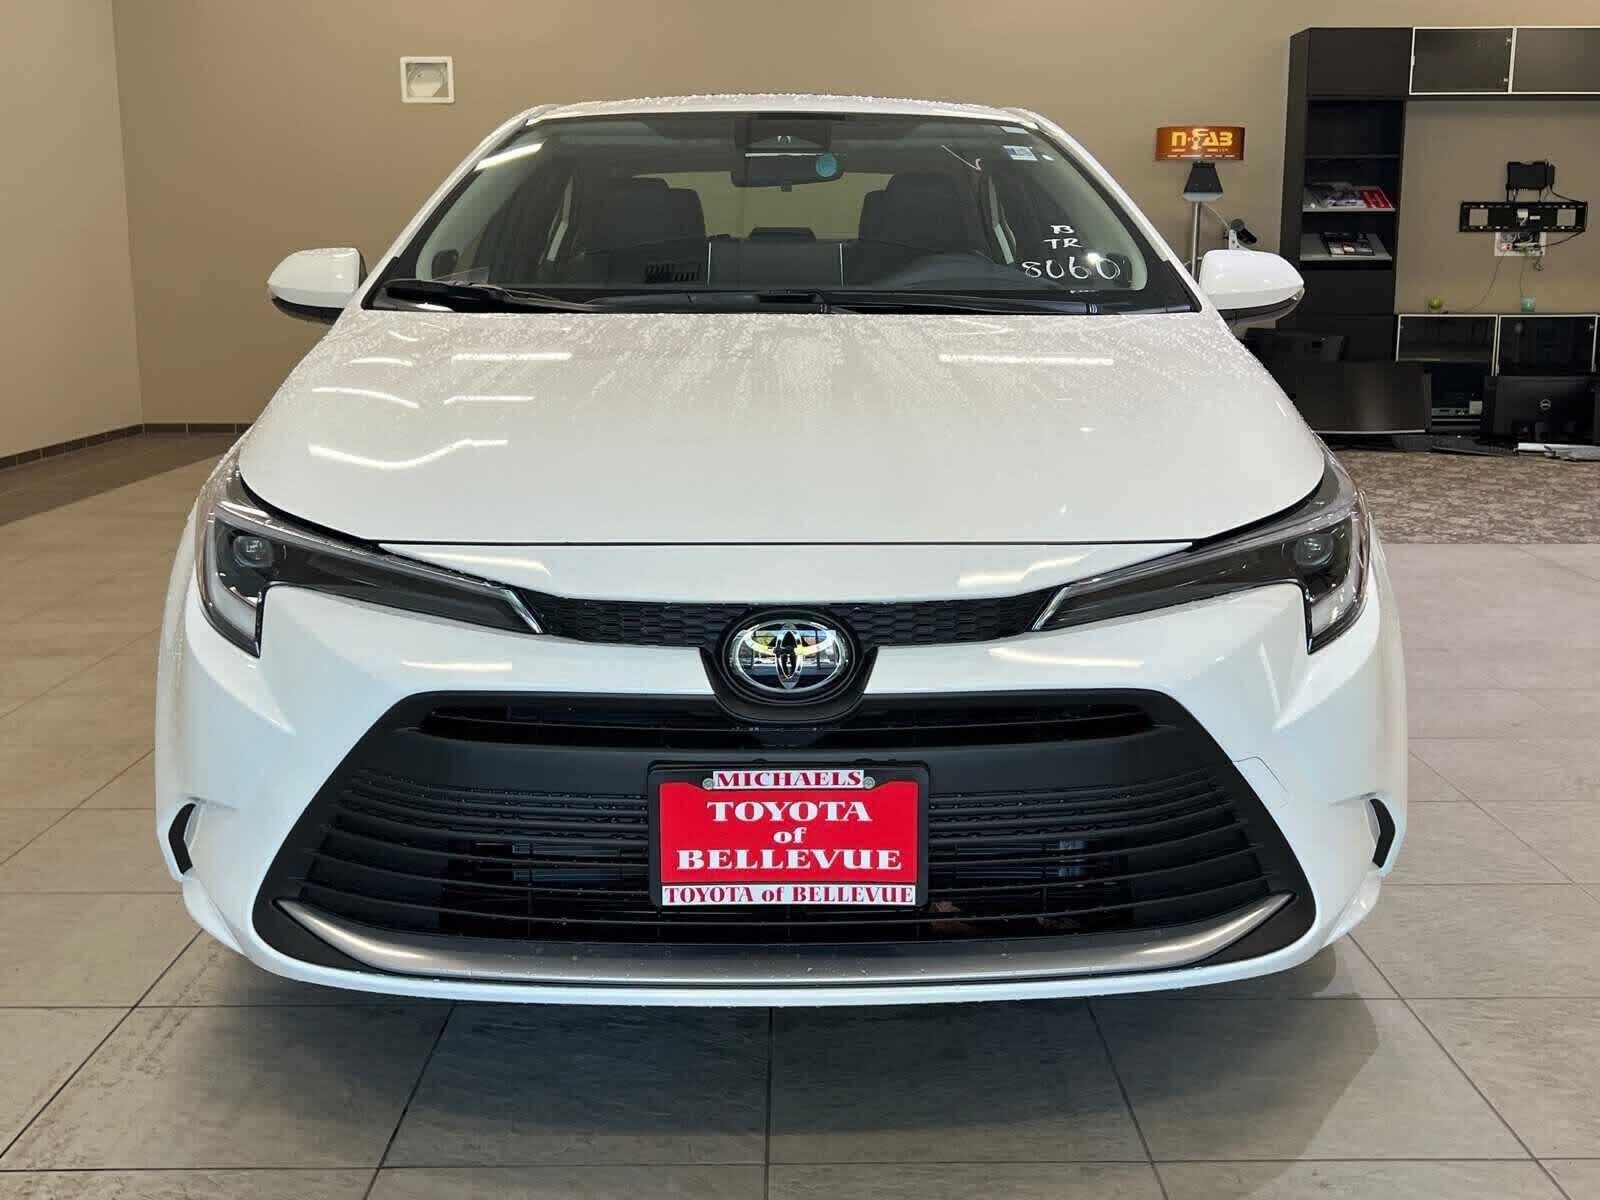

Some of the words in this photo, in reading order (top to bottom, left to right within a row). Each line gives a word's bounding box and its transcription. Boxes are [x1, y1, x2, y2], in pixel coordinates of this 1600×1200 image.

[716, 771, 861, 787] MICHAELS
[706, 801, 872, 822] TOYOTA
[773, 827, 807, 844] of
[676, 849, 902, 870] BELLEVUE
[664, 887, 753, 903] TOYOTA
[761, 887, 784, 902] of
[793, 887, 913, 903] BELLEVUE
